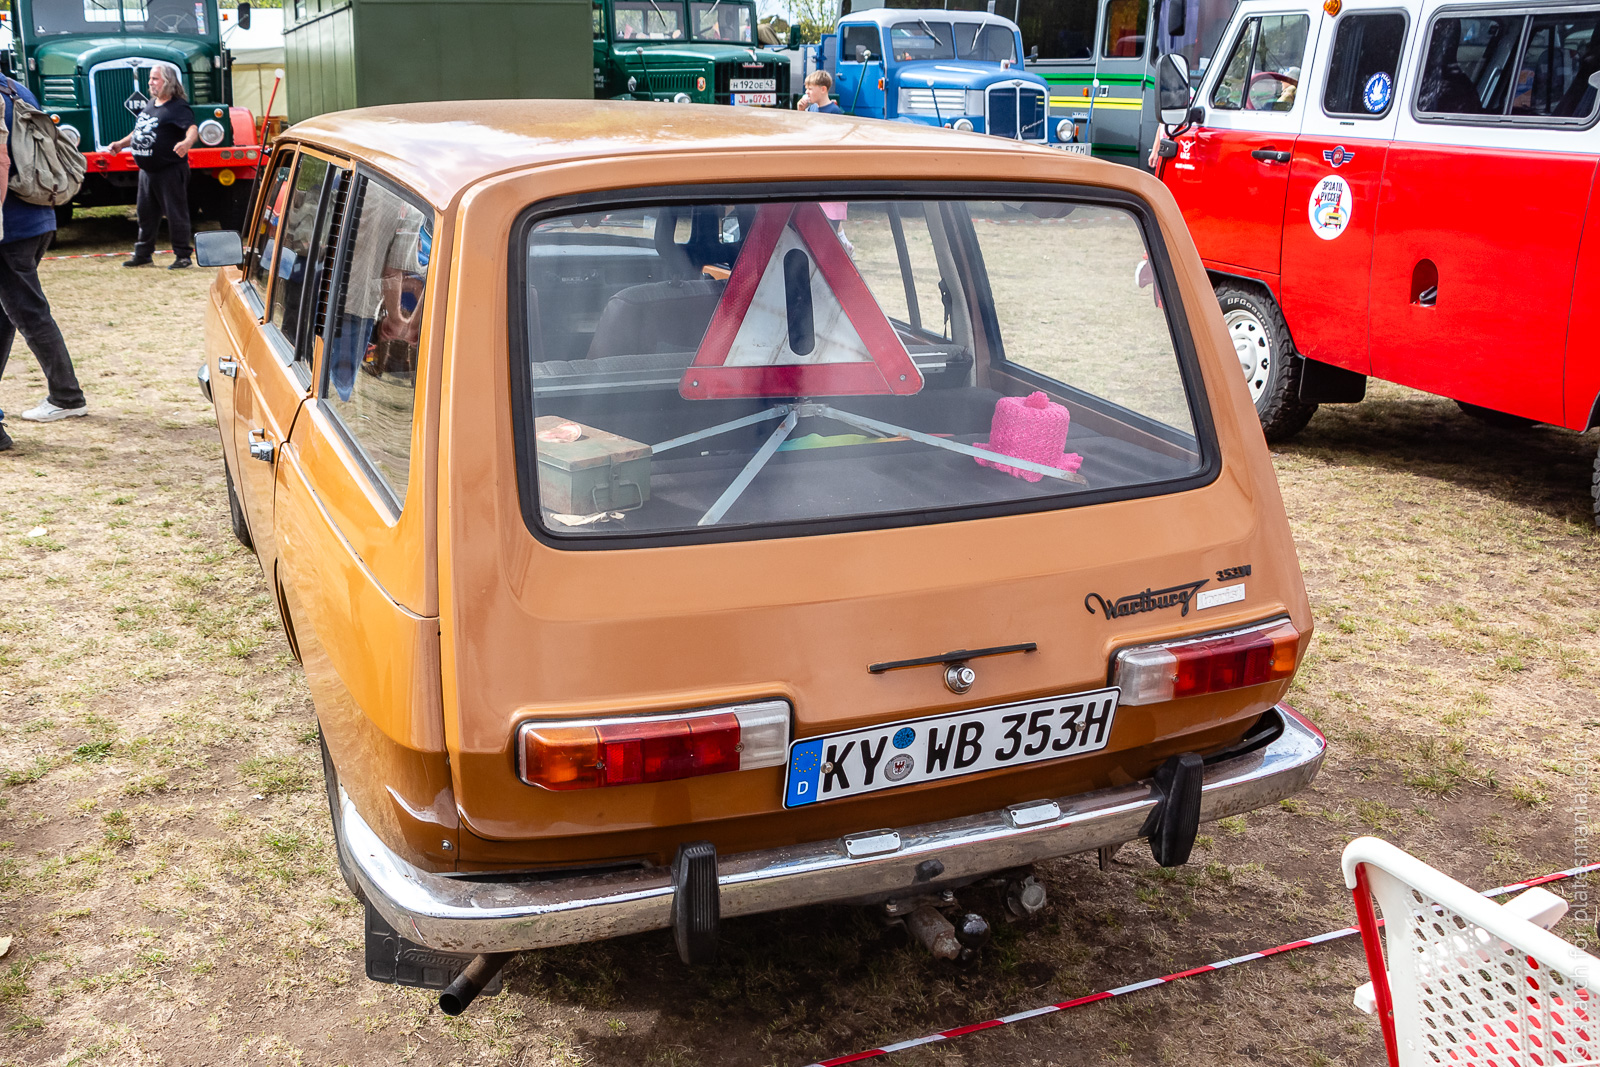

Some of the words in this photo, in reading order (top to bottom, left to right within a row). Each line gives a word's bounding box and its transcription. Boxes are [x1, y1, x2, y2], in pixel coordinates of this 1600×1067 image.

[128, 100, 147, 109] IFA
[753, 95, 771, 103] 0761
[1084, 578, 1210, 620] Wartburg
[823, 736, 888, 793] KY
[926, 721, 985, 774] WB
[995, 699, 1113, 761] 353H
[797, 781, 809, 795] D
